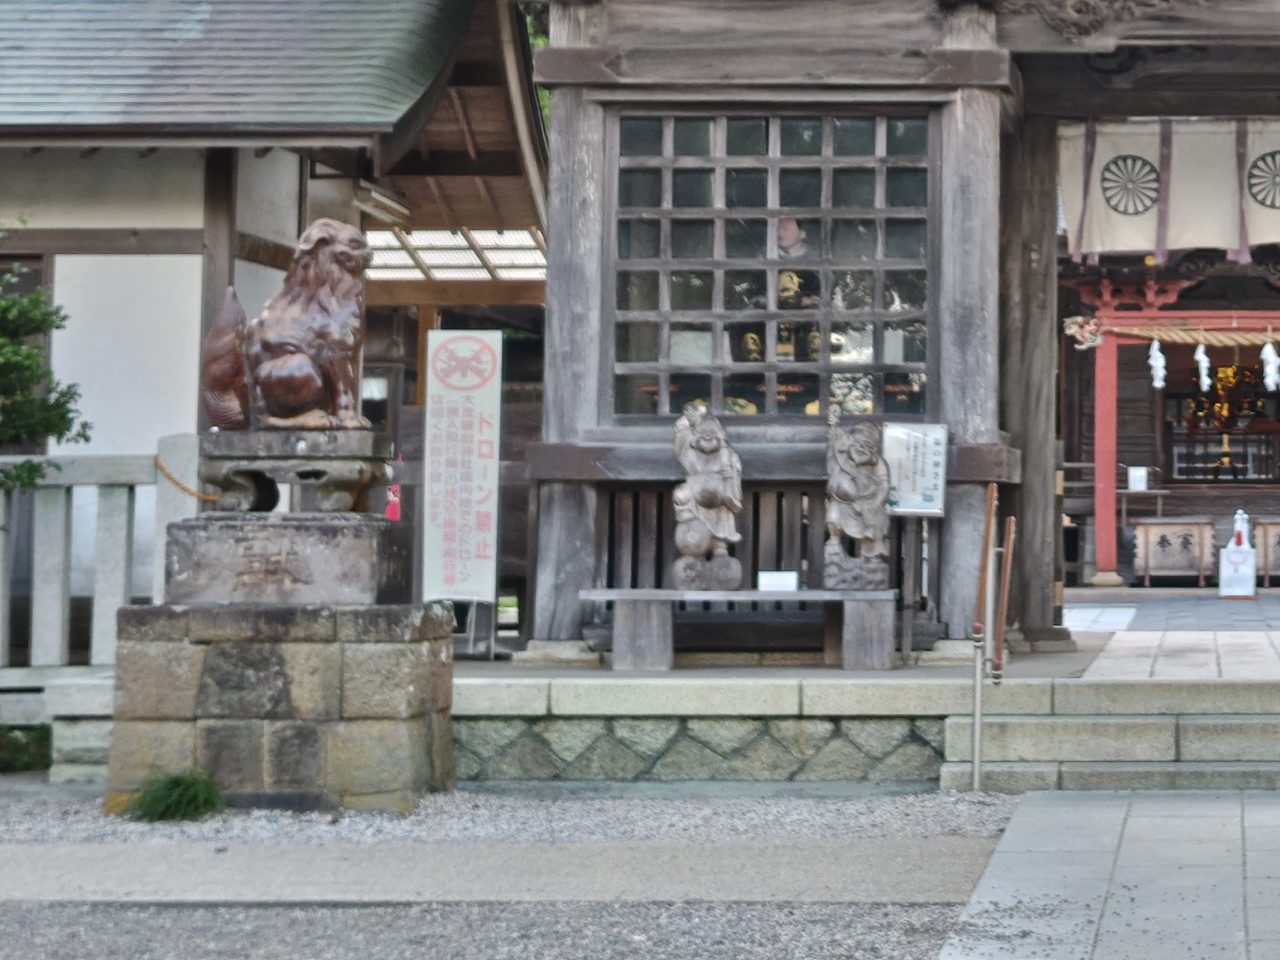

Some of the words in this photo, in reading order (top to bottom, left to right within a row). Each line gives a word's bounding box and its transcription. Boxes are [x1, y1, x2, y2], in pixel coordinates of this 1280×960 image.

[475, 411, 495, 561] ドローン禁止
